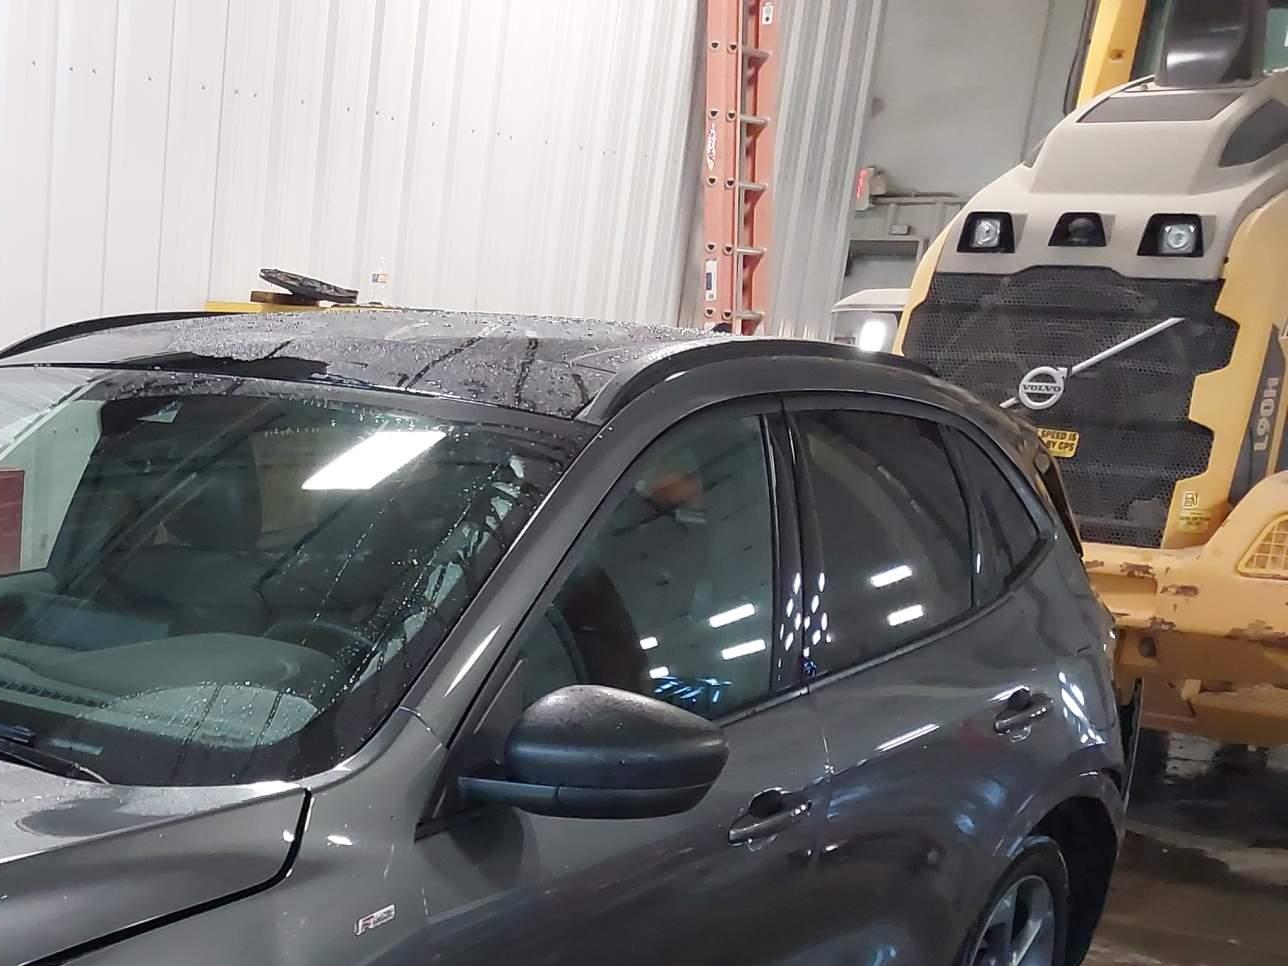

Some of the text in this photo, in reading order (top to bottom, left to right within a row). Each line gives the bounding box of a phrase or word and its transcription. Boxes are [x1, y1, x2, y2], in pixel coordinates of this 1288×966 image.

[1022, 384, 1062, 393] VOLVO
[1253, 377, 1280, 451] L90H
[1041, 430, 1077, 441] SPEED IS
